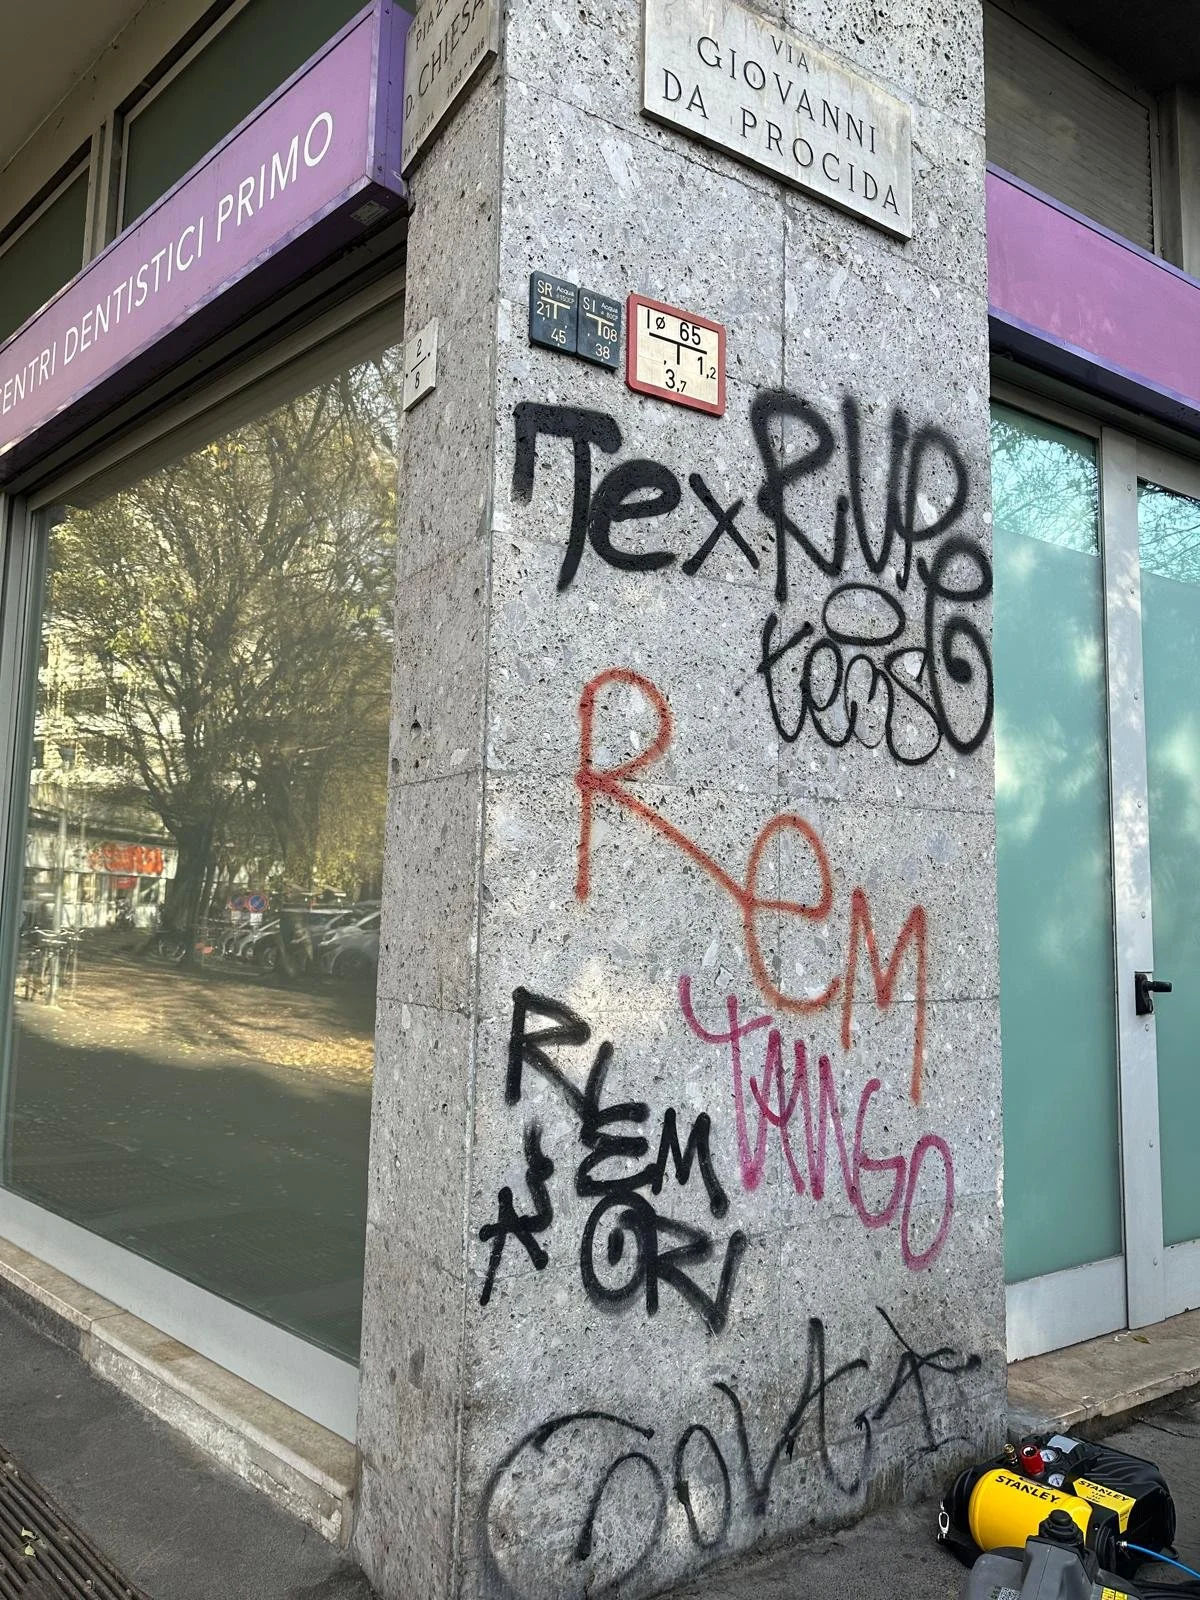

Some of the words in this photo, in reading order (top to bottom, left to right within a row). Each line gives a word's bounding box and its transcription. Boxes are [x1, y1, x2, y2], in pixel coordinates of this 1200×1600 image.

[770, 34, 809, 73] VIA
[405, 94, 415, 120] D.
[697, 36, 876, 154] GIOVANNI
[403, 111, 435, 162] PATRIOTA
[662, 67, 710, 119] DA
[740, 106, 900, 215] PROCIDA
[0, 341, 57, 415] ENTRI
[63, 215, 205, 366] DENTISTICI
[216, 111, 334, 243] PRIMO
[537, 280, 553, 297] SR
[551, 328, 566, 344] 45
[679, 321, 702, 346] 65
[595, 343, 610, 359] 38
[665, 368, 687, 393] 3,7
[697, 356, 717, 380] 1,2
[994, 1474, 1061, 1505] STANLEY
[1078, 1480, 1130, 1502] STANLEY
